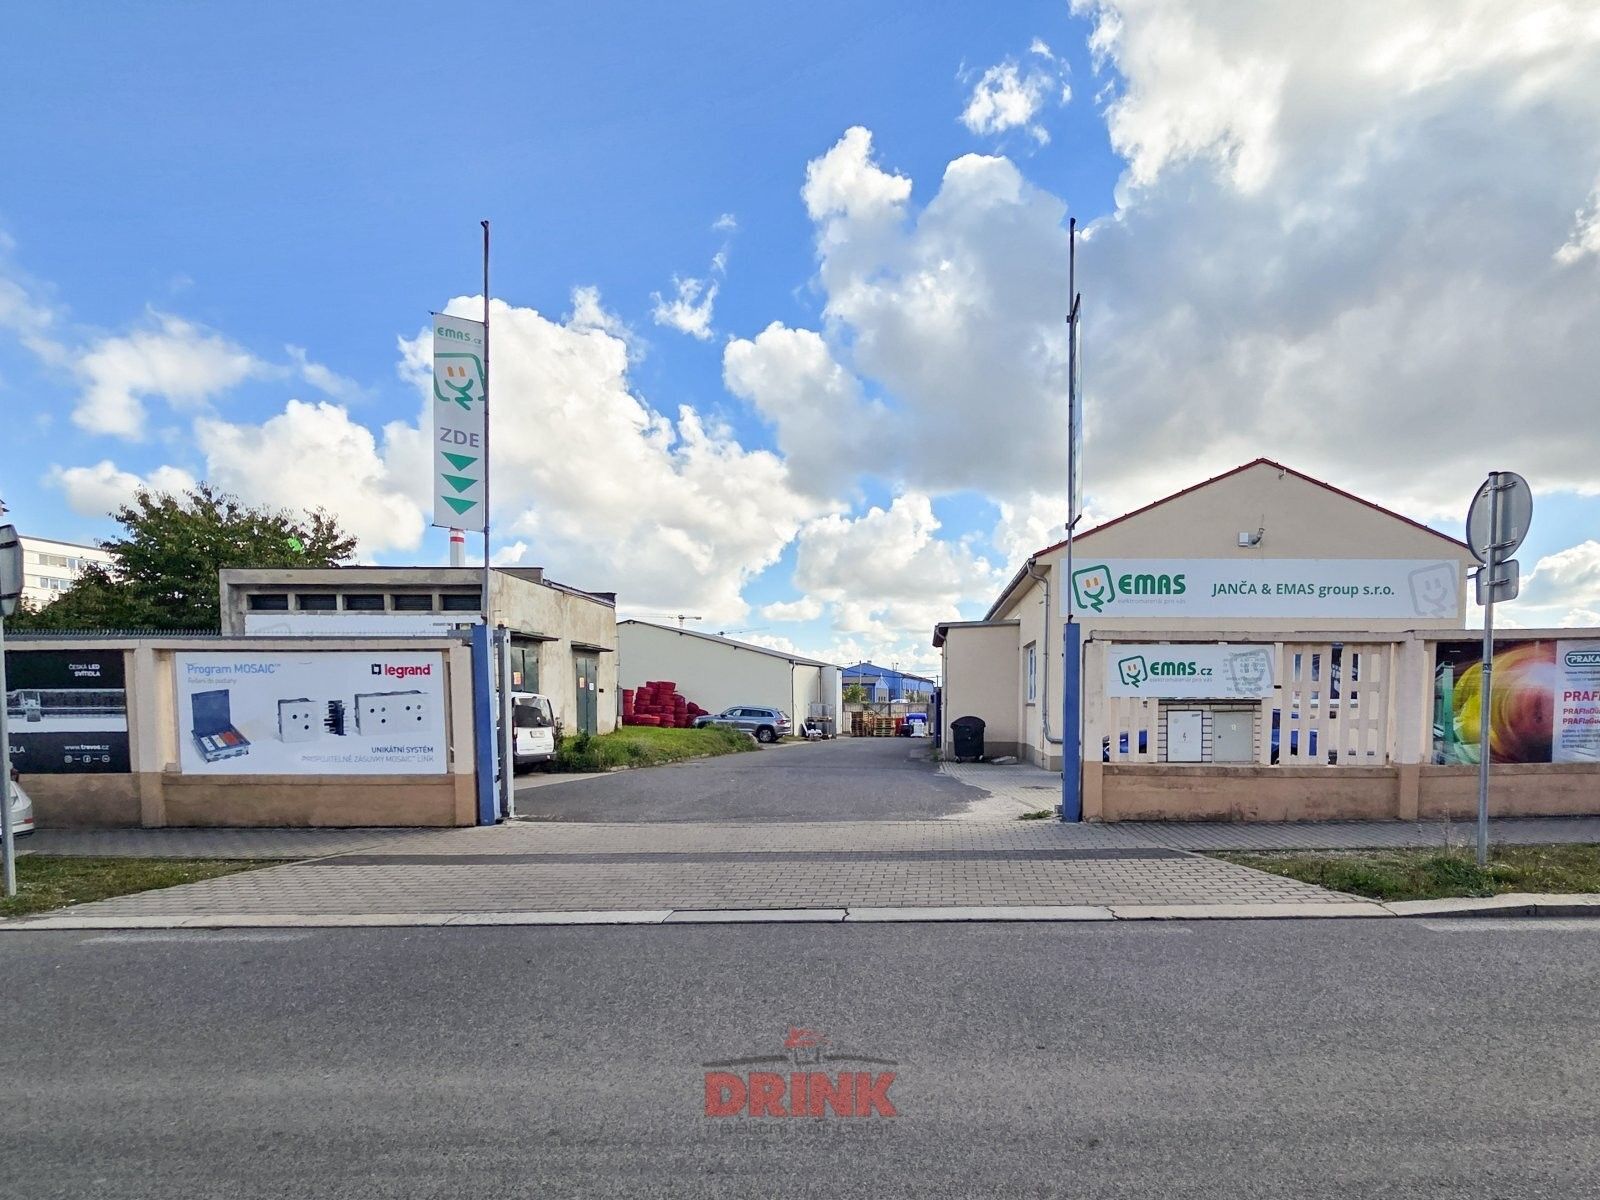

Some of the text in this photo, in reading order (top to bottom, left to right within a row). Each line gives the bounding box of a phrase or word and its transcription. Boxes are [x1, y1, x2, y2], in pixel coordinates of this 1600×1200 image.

[437, 326, 482, 345] EMAS.cz
[440, 427, 479, 448] ZDE
[1118, 574, 1186, 595] EMAS
[1211, 580, 1395, 598] JANČA & EMAS group s.r.o.
[187, 663, 232, 677] Program
[384, 664, 431, 679] legrand
[1150, 661, 1213, 676] EMAS.cz
[371, 745, 435, 754] UNIKÁTNÍ SYSTÉM
